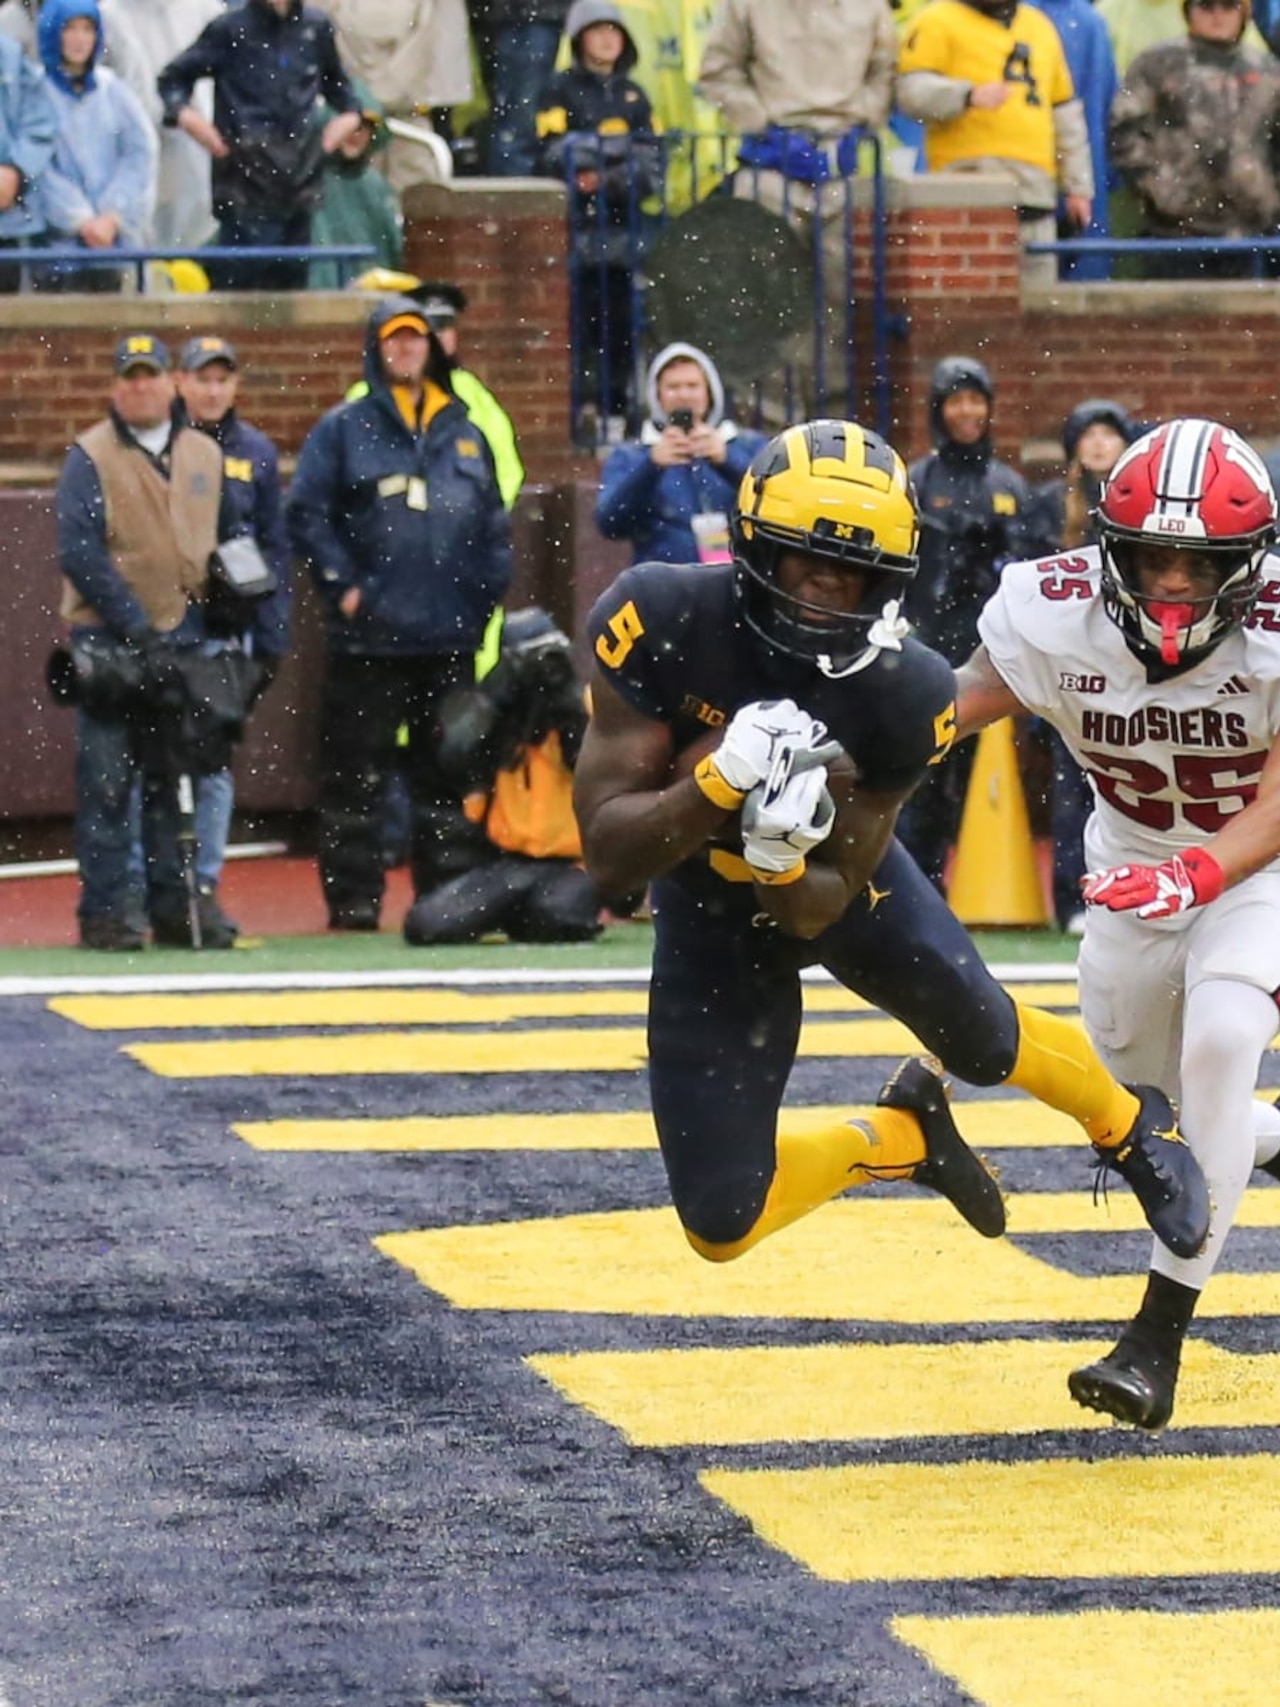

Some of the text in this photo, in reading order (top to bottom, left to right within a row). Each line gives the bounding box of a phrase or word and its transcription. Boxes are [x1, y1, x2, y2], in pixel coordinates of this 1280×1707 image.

[834, 523, 855, 540] M
[1158, 518, 1186, 533] LEO
[1037, 556, 1092, 601] 25
[595, 600, 645, 669] 5
[927, 701, 957, 766] 5
[1082, 707, 1248, 748] HOOSIERS
[1080, 749, 1269, 834] 25
